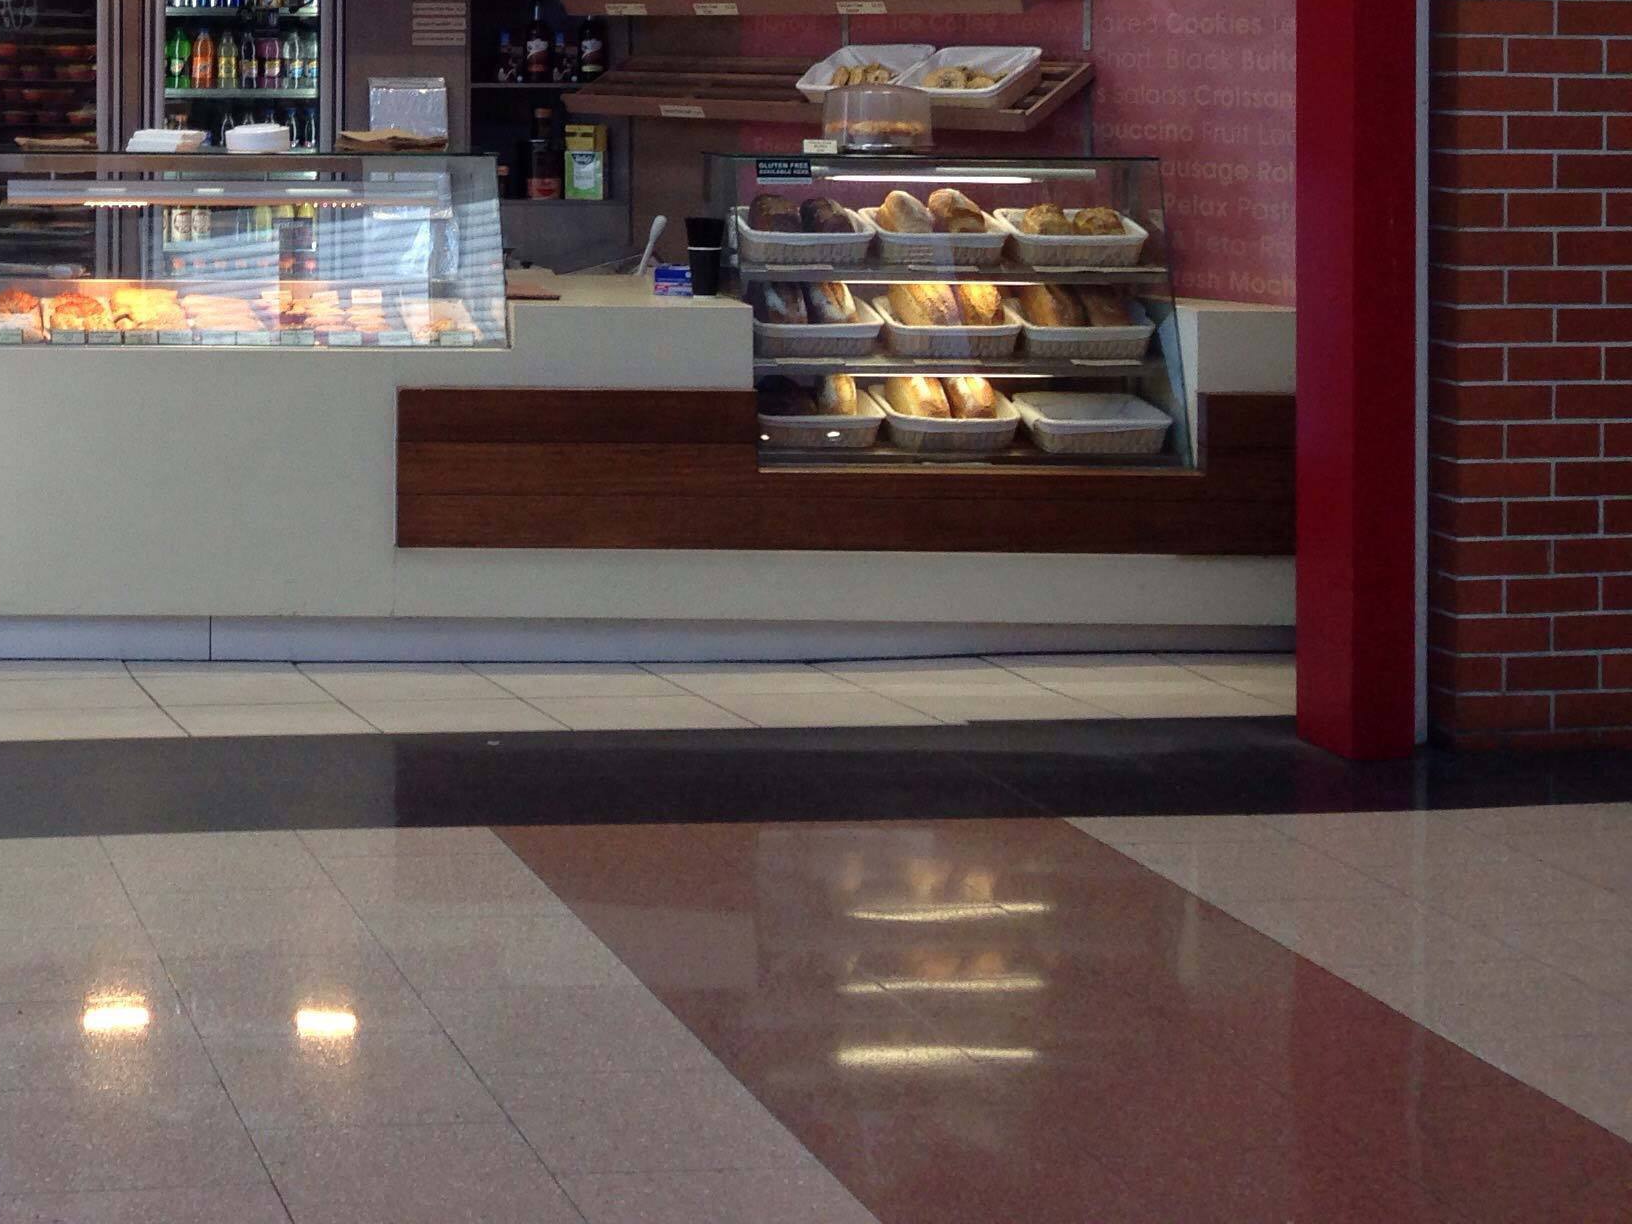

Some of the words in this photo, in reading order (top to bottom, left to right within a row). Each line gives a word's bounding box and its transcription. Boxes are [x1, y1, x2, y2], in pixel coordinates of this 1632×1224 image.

[1167, 10, 1262, 36] Cookies
[1166, 47, 1231, 71] Black
[790, 162, 809, 170] FREE
[1161, 159, 1249, 187] ausage
